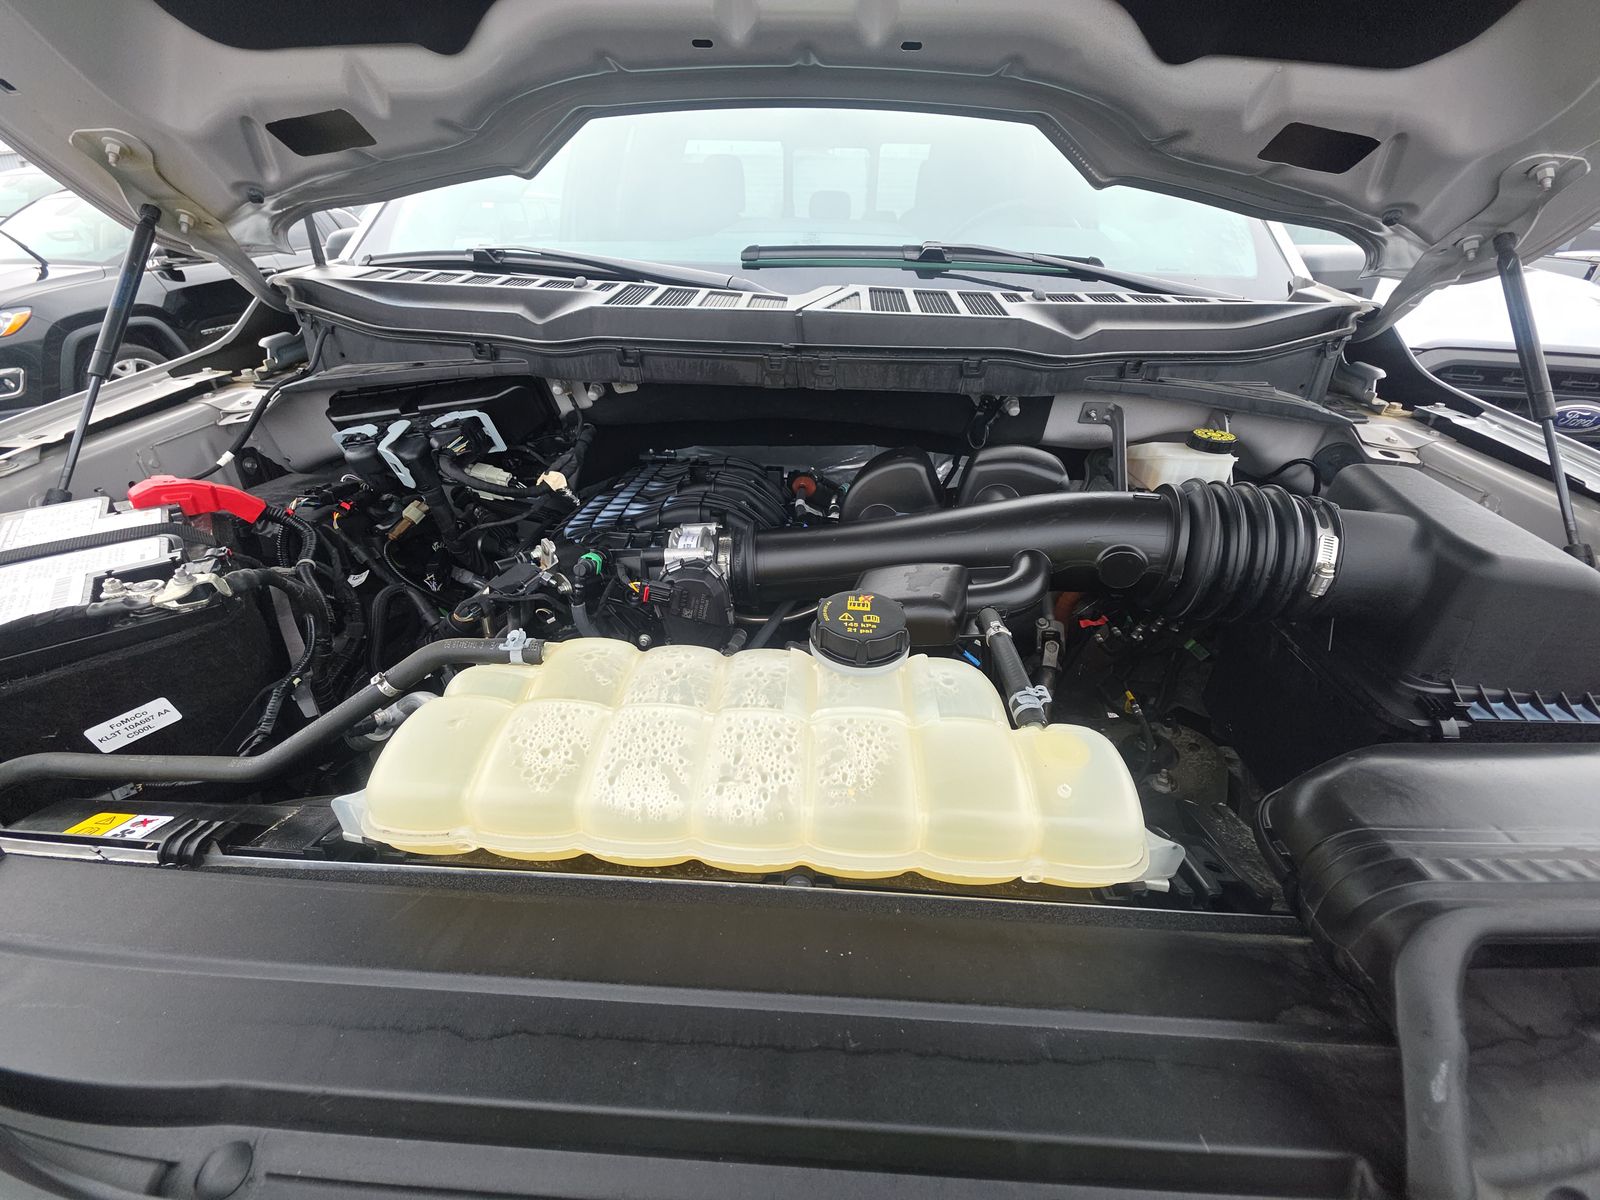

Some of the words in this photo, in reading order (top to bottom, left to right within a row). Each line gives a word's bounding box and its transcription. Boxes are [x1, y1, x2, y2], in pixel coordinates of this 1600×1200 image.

[1558, 410, 1598, 427] Ford
[98, 730, 122, 743] KL3T
[157, 708, 171, 718] AA
[109, 710, 148, 730] FoMoCo
[126, 724, 155, 739] C500L
